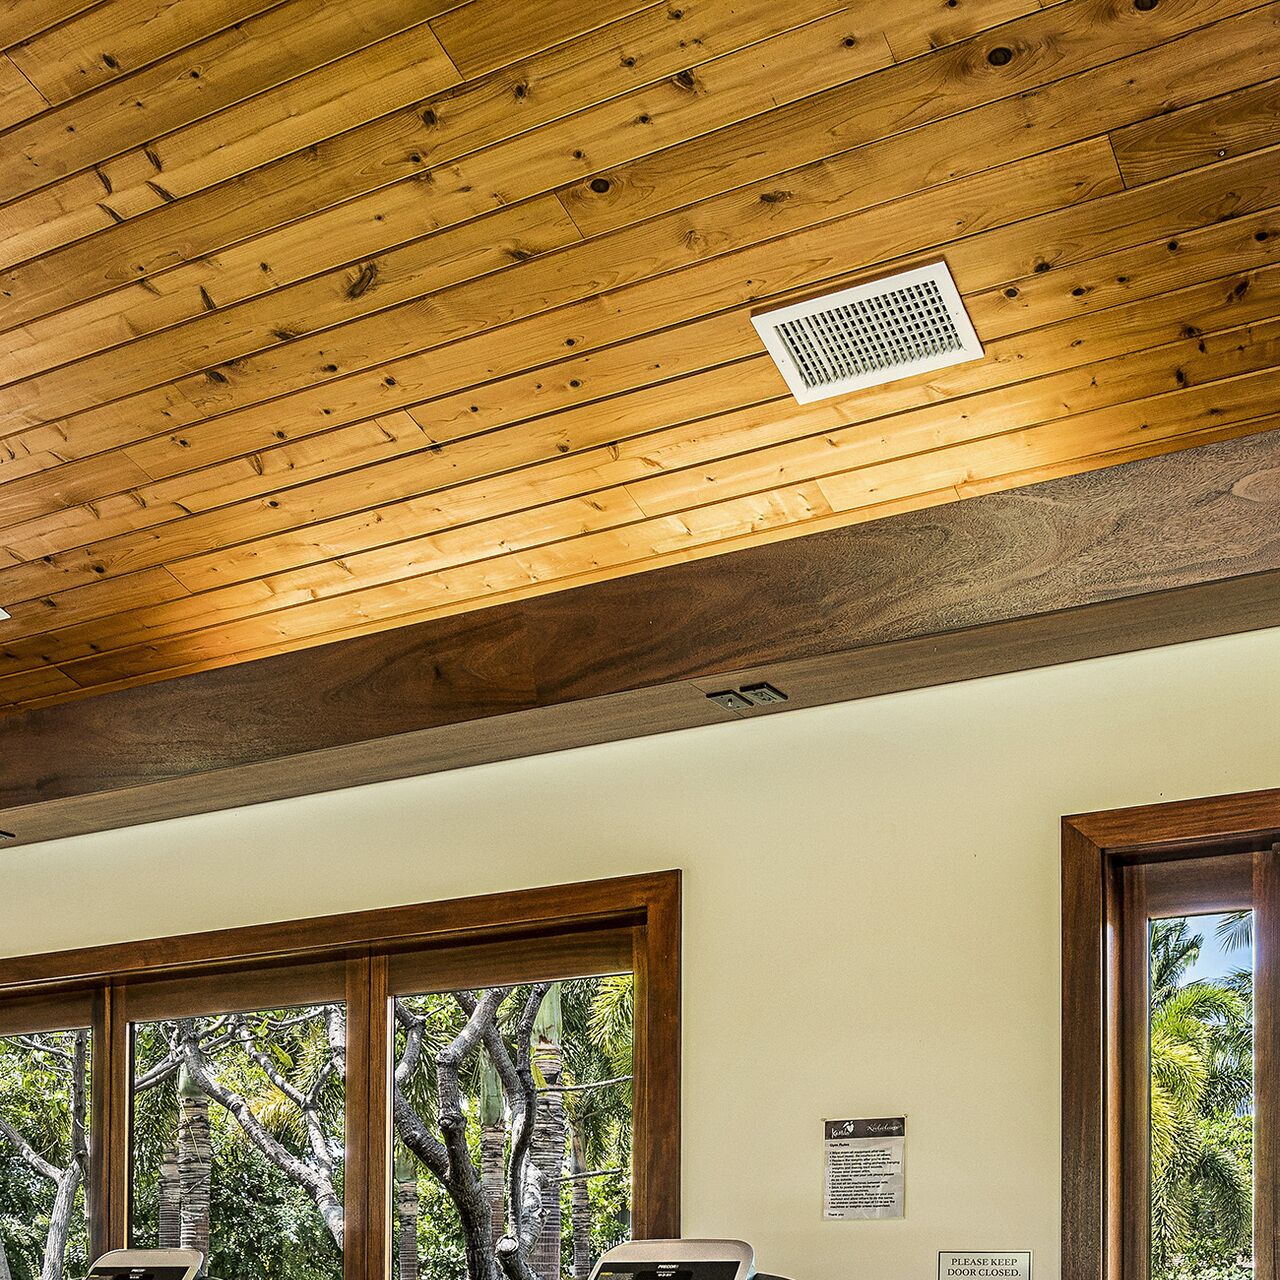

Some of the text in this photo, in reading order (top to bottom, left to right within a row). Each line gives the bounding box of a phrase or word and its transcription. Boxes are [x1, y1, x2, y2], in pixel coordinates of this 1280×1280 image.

[951, 1258, 1018, 1266] PLEASE KEEP
[947, 1268, 1021, 1277] DOOR CLOSED.
